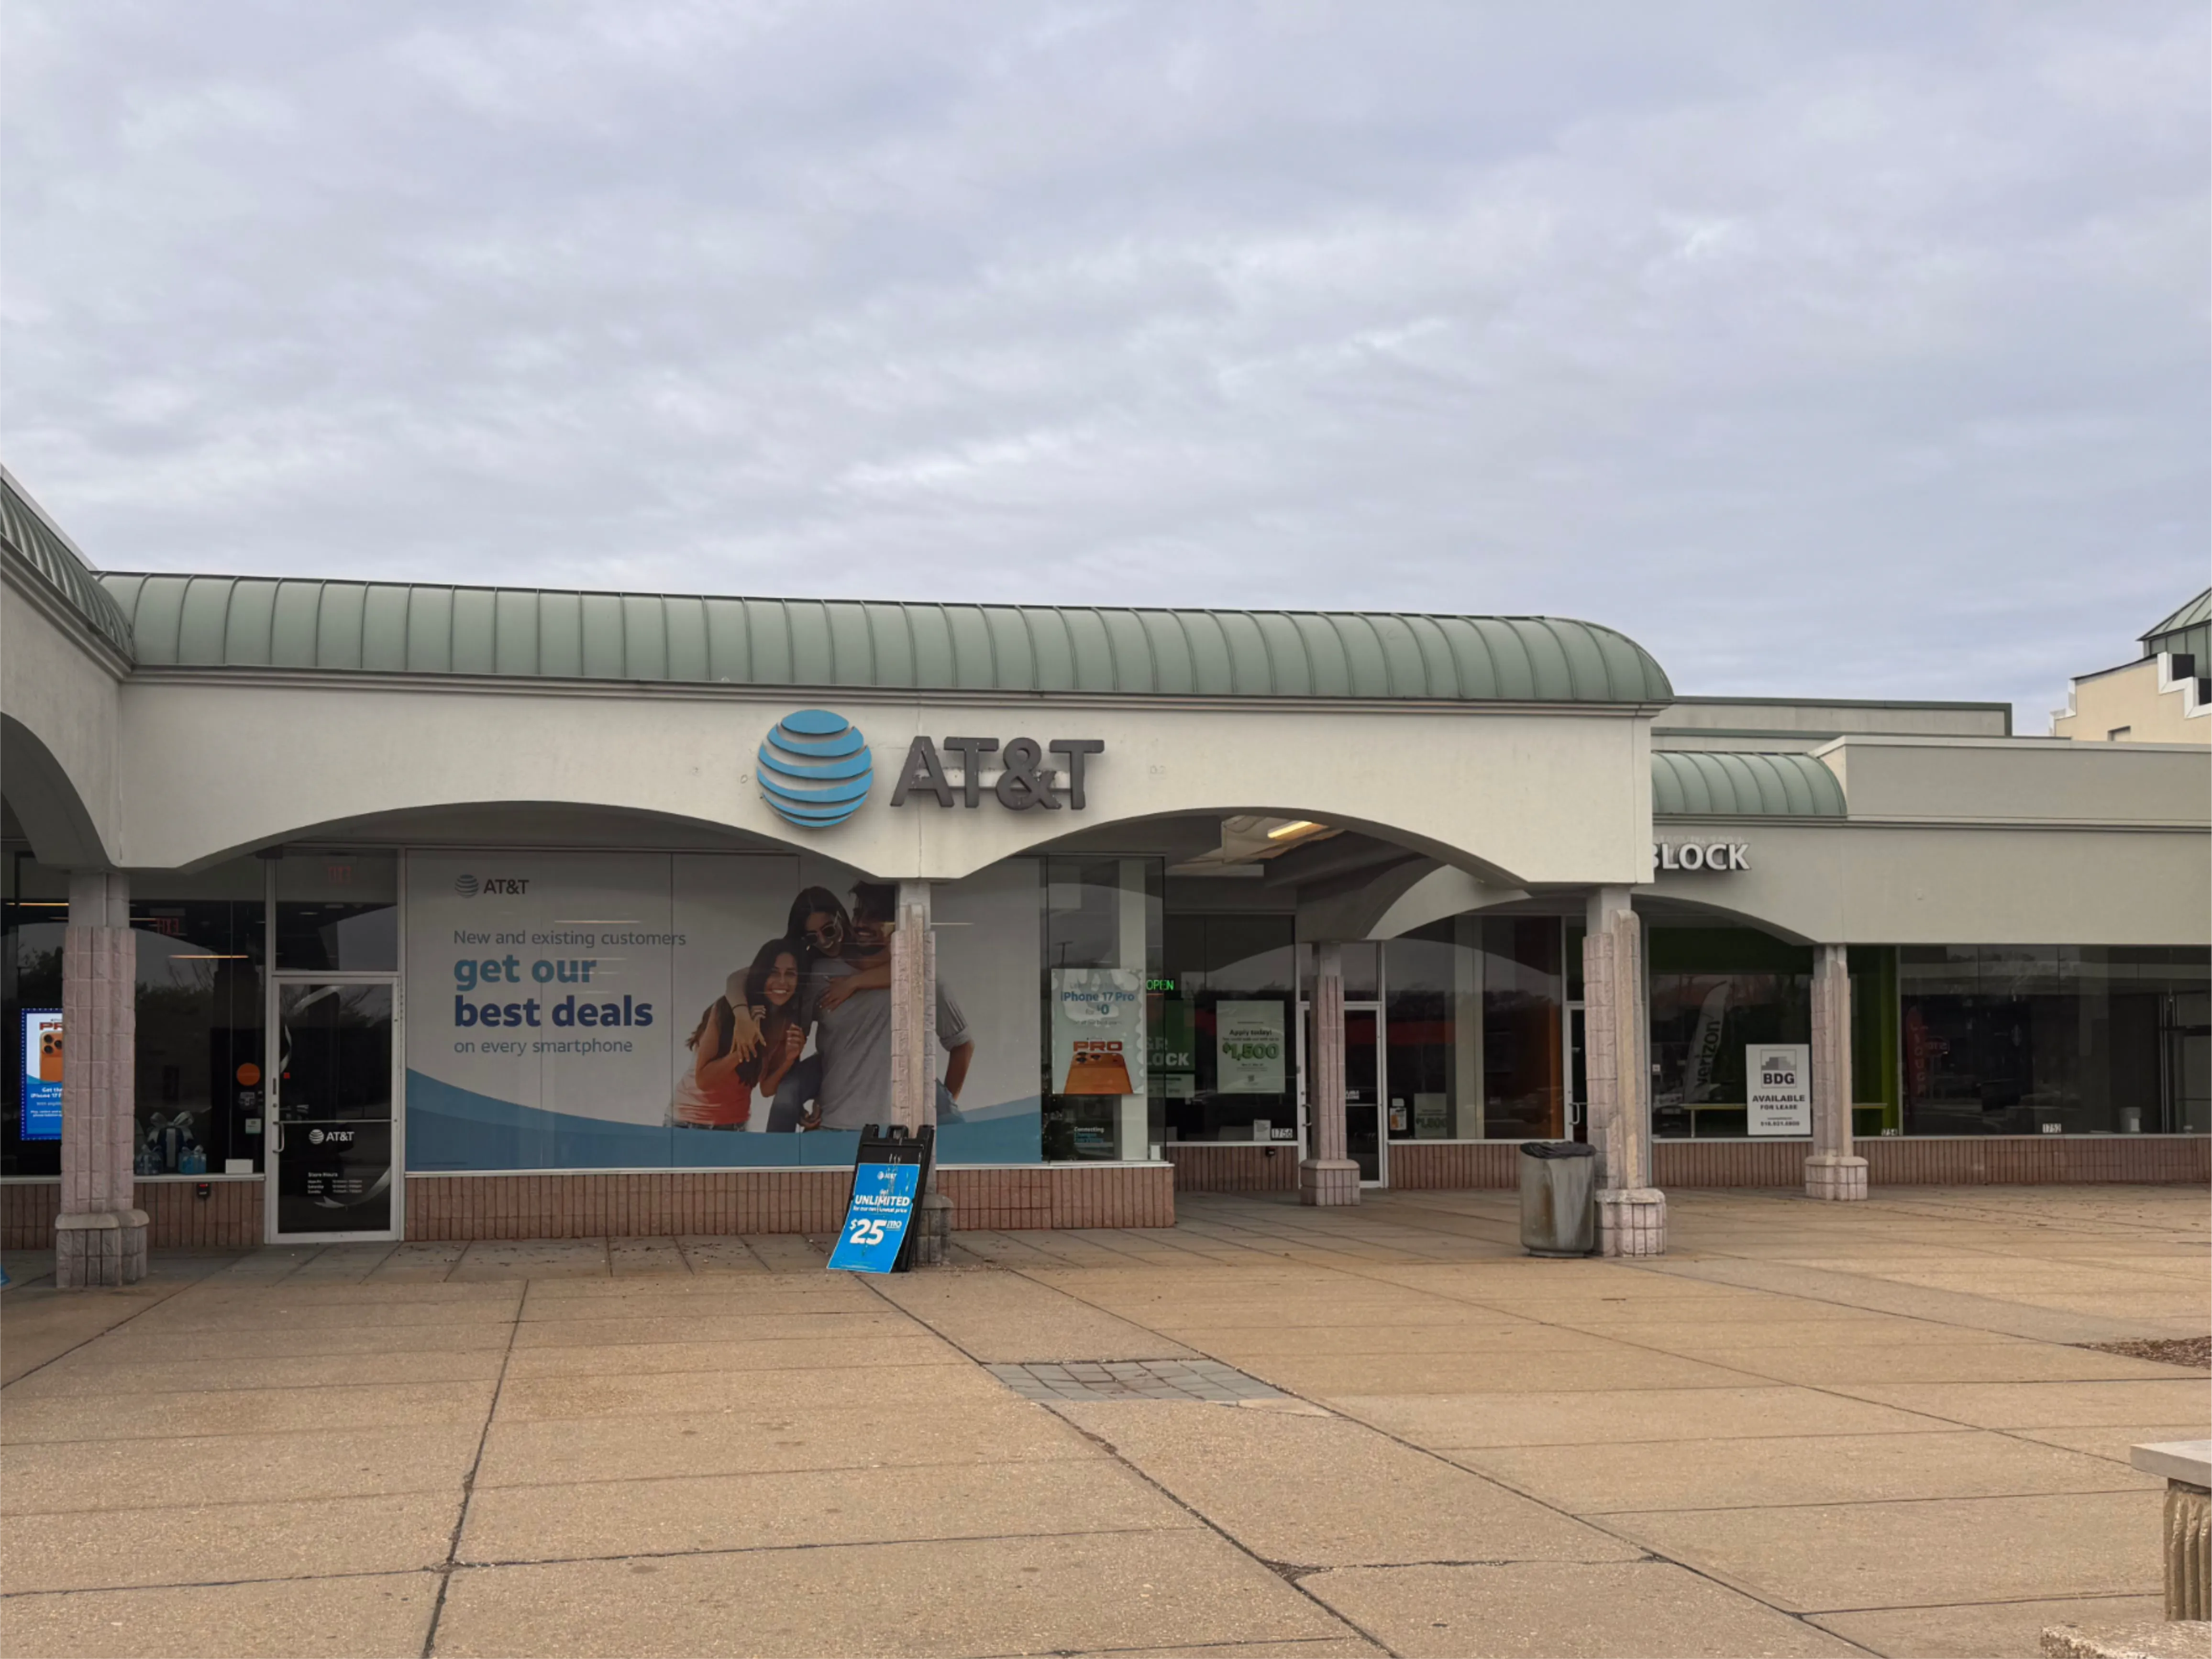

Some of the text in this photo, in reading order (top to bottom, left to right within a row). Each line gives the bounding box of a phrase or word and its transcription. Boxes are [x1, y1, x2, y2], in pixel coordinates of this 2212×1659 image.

[890, 736, 1105, 811] AT&T
[483, 879, 529, 895] AT&T
[454, 930, 686, 948] New and existing customers
[453, 954, 597, 992] get our
[1147, 980, 1174, 990] OPEN
[1061, 991, 1135, 1001] iPhone 17 Pro
[454, 995, 653, 1027] best deals
[1250, 1029, 1272, 1037] today!
[453, 1038, 633, 1057] on every smartphone
[1073, 1041, 1123, 1052] PRO
[1222, 1042, 1280, 1061] $1,500
[1695, 1020, 1721, 1088] verizon
[1147, 1052, 1190, 1066] OCK
[1763, 1073, 1795, 1084] BDG
[326, 1131, 355, 1142] AT&T
[854, 1194, 910, 1206] UNLIMITED
